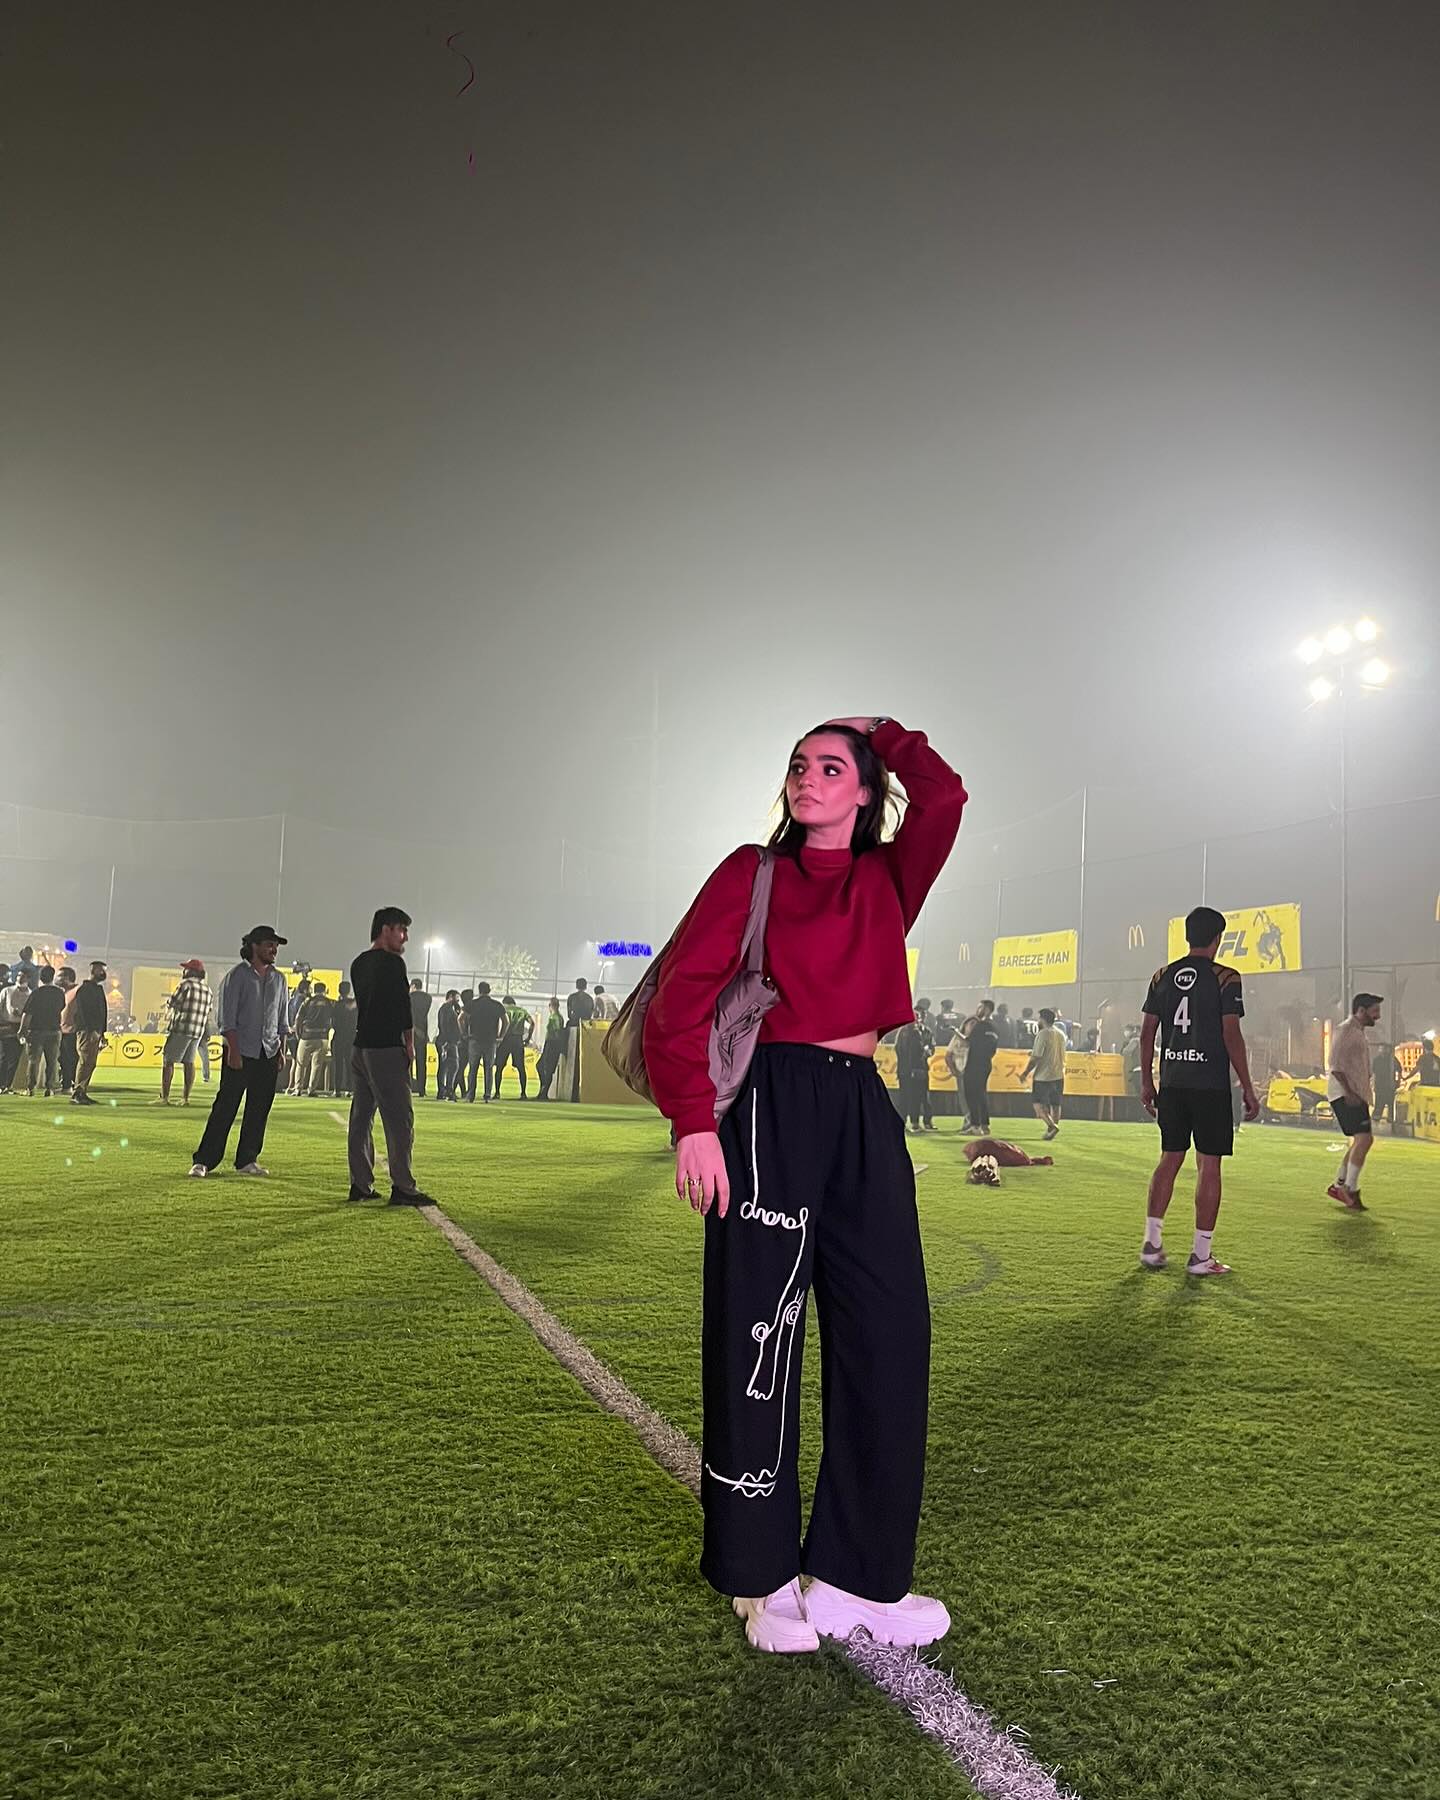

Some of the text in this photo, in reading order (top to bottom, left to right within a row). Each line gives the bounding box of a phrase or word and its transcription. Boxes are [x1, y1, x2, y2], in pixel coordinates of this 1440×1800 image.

[999, 950, 1070, 967] BAREEZE MAN
[1177, 975, 1194, 983] PEL
[1173, 996, 1191, 1034] 4
